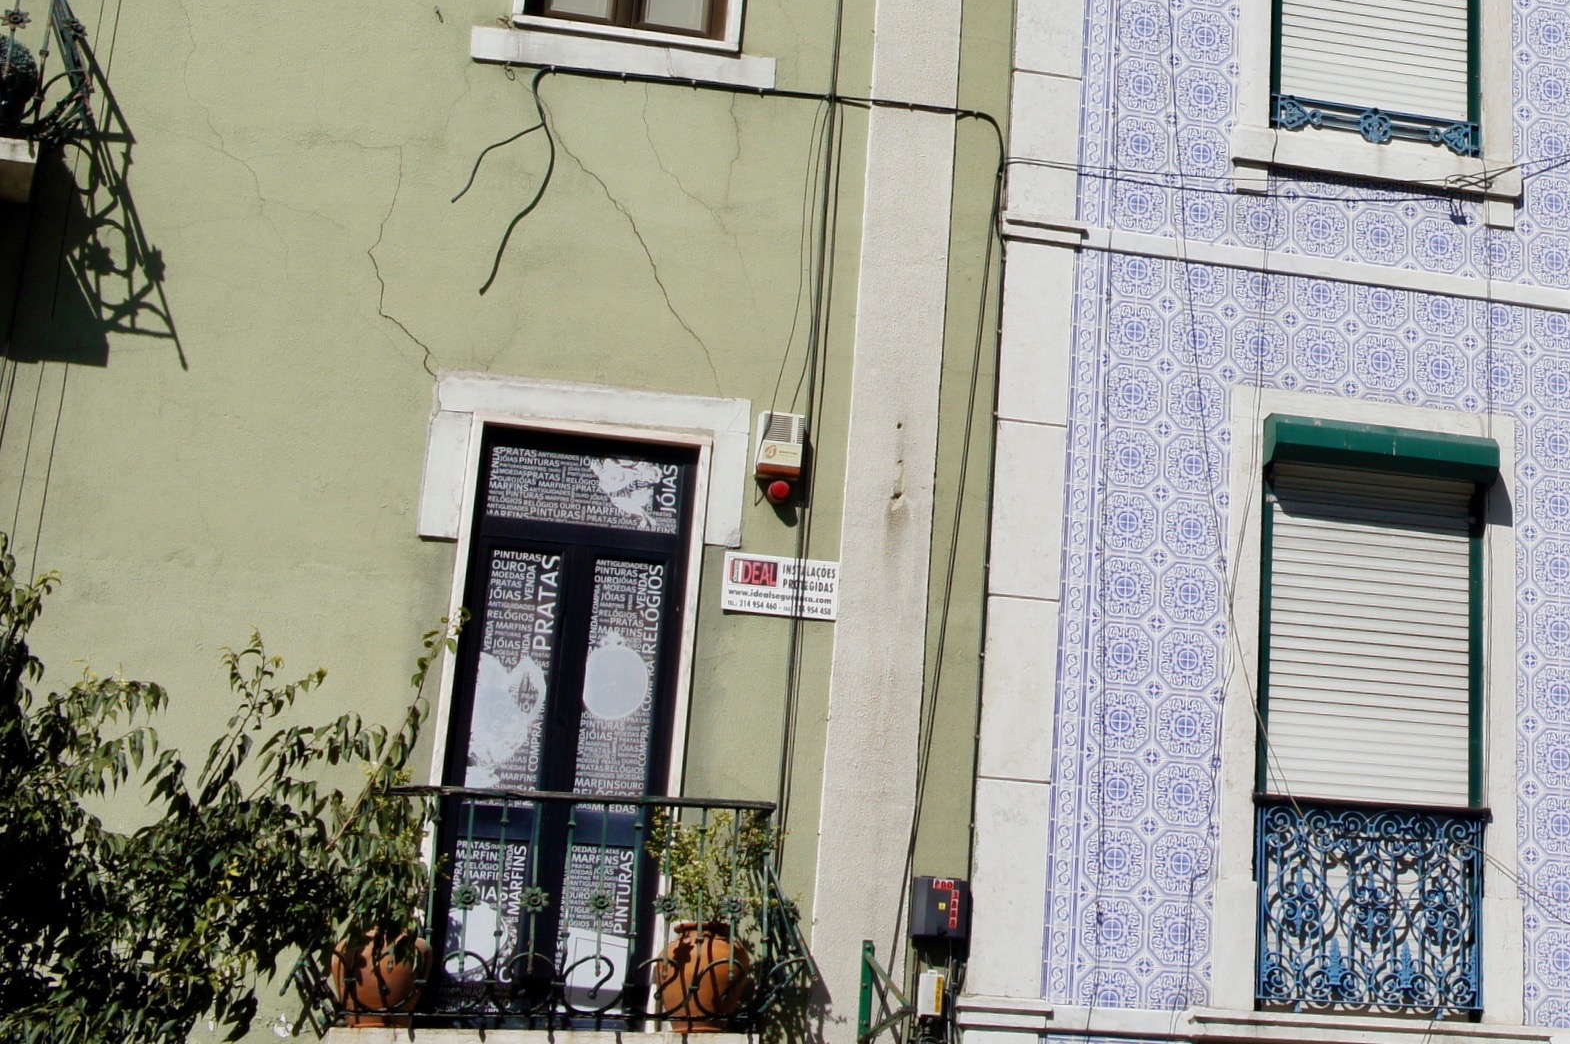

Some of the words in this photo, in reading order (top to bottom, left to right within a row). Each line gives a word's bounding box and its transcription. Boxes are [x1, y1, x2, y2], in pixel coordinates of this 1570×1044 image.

[500, 447, 537, 458] PRATAS
[538, 452, 579, 461] ANTIGUIDADES
[490, 447, 501, 480] VENDA
[500, 455, 518, 463] JÓIAS
[519, 457, 560, 467] PINTURAS
[499, 468, 527, 477] MOEDAS
[527, 471, 560, 481] PRATAS
[489, 481, 529, 492] MARFINS
[530, 487, 570, 496] ANTIGUIDADES
[517, 475, 537, 485] JÓIAS
[538, 481, 571, 490] MARFINS
[575, 485, 605, 494] PRATA
[656, 465, 678, 513] JÓIAS
[505, 490, 544, 500] PINTURAS
[487, 496, 522, 504] RELÓGIOS
[523, 499, 558, 509] RELÓGIOS
[487, 503, 528, 511] ANTIGUIDADES
[530, 507, 581, 520] PINTURAS
[587, 505, 632, 518] MARFINS
[586, 514, 617, 524] PRATAS
[618, 516, 638, 526] JÓIAS
[494, 549, 541, 562] PINTURAS
[492, 559, 527, 572] OURO
[596, 559, 649, 570] ANTIGUIDADES
[491, 570, 525, 580] MOEDAS
[595, 566, 638, 577] PINTURAS
[731, 559, 778, 587] IDEAL
[490, 578, 522, 588] PRATAS
[524, 564, 537, 601] VENDA
[594, 575, 617, 584] OURO
[618, 576, 638, 585] JÓIAS
[489, 587, 521, 601] JÓIAS
[603, 584, 637, 593] MOEDAS
[636, 572, 648, 609] VENDA
[532, 555, 561, 651] PRATAS
[592, 584, 601, 614] COMPRA
[601, 591, 626, 602] JÓIAS
[488, 600, 536, 611] ANTIGUIDADES
[600, 601, 624, 609] MARFINS
[640, 564, 664, 655] RELÓGIOS
[739, 599, 751, 608] 214
[752, 600, 764, 609] 954
[487, 608, 535, 622] RELÓGIOS
[598, 609, 638, 619] RELÓGIOS
[495, 621, 533, 632] MARFINS
[609, 617, 644, 627] PRATAS
[483, 620, 494, 651] VENDA
[588, 615, 598, 645] VENDA
[597, 625, 643, 638] MARFINS
[493, 636, 521, 650] JÓIAS
[520, 633, 531, 658] ENDA
[580, 719, 626, 730] PINTURAS
[586, 728, 613, 741] JÓIAS
[528, 722, 543, 772] COMPRA
[577, 728, 586, 755] VENDA
[638, 724, 649, 767] COMPRA
[584, 746, 611, 755] PRATAS
[617, 743, 640, 753] JÓIAS
[576, 763, 604, 772] PRATAS
[604, 764, 645, 774] RELÓGIOS
[500, 772, 537, 783] MARFINS
[616, 773, 645, 781] MOEDAS
[574, 777, 620, 791] MARFINS
[620, 781, 644, 790] OURO
[455, 849, 505, 862] MRFIN
[571, 845, 597, 854] OEDAS
[505, 844, 515, 871] VENDA
[571, 853, 620, 865] MARFNS
[464, 860, 503, 871] ELÓGIO
[507, 845, 527, 916] MARFINS
[570, 880, 616, 889] ANTIGUIDDES
[612, 850, 635, 934] PINTURAS
